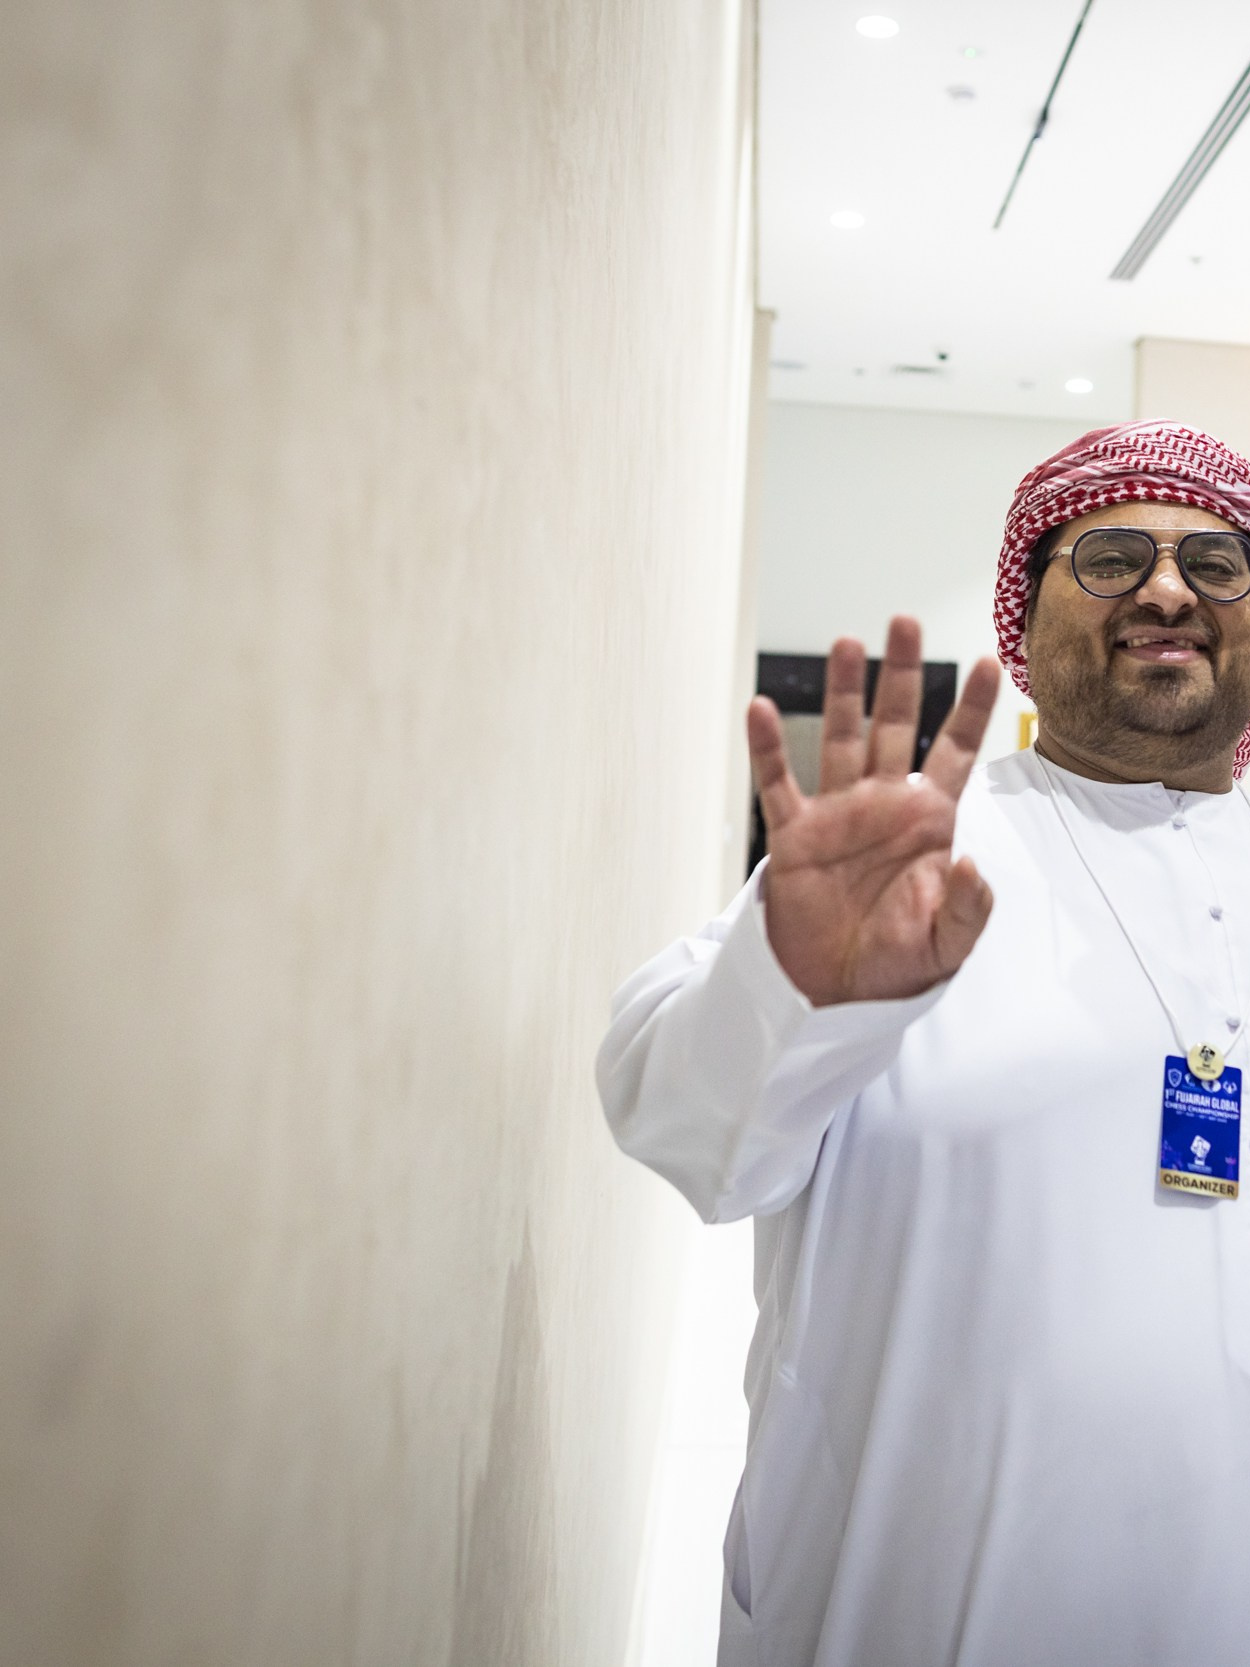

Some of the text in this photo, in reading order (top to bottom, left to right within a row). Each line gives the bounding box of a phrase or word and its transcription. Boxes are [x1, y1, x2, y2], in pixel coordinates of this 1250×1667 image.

[1175, 1090, 1211, 1108] FUJAIRAH
[1211, 1097, 1239, 1114] GLOBAL
[1163, 1173, 1235, 1196] ORGANIZER
